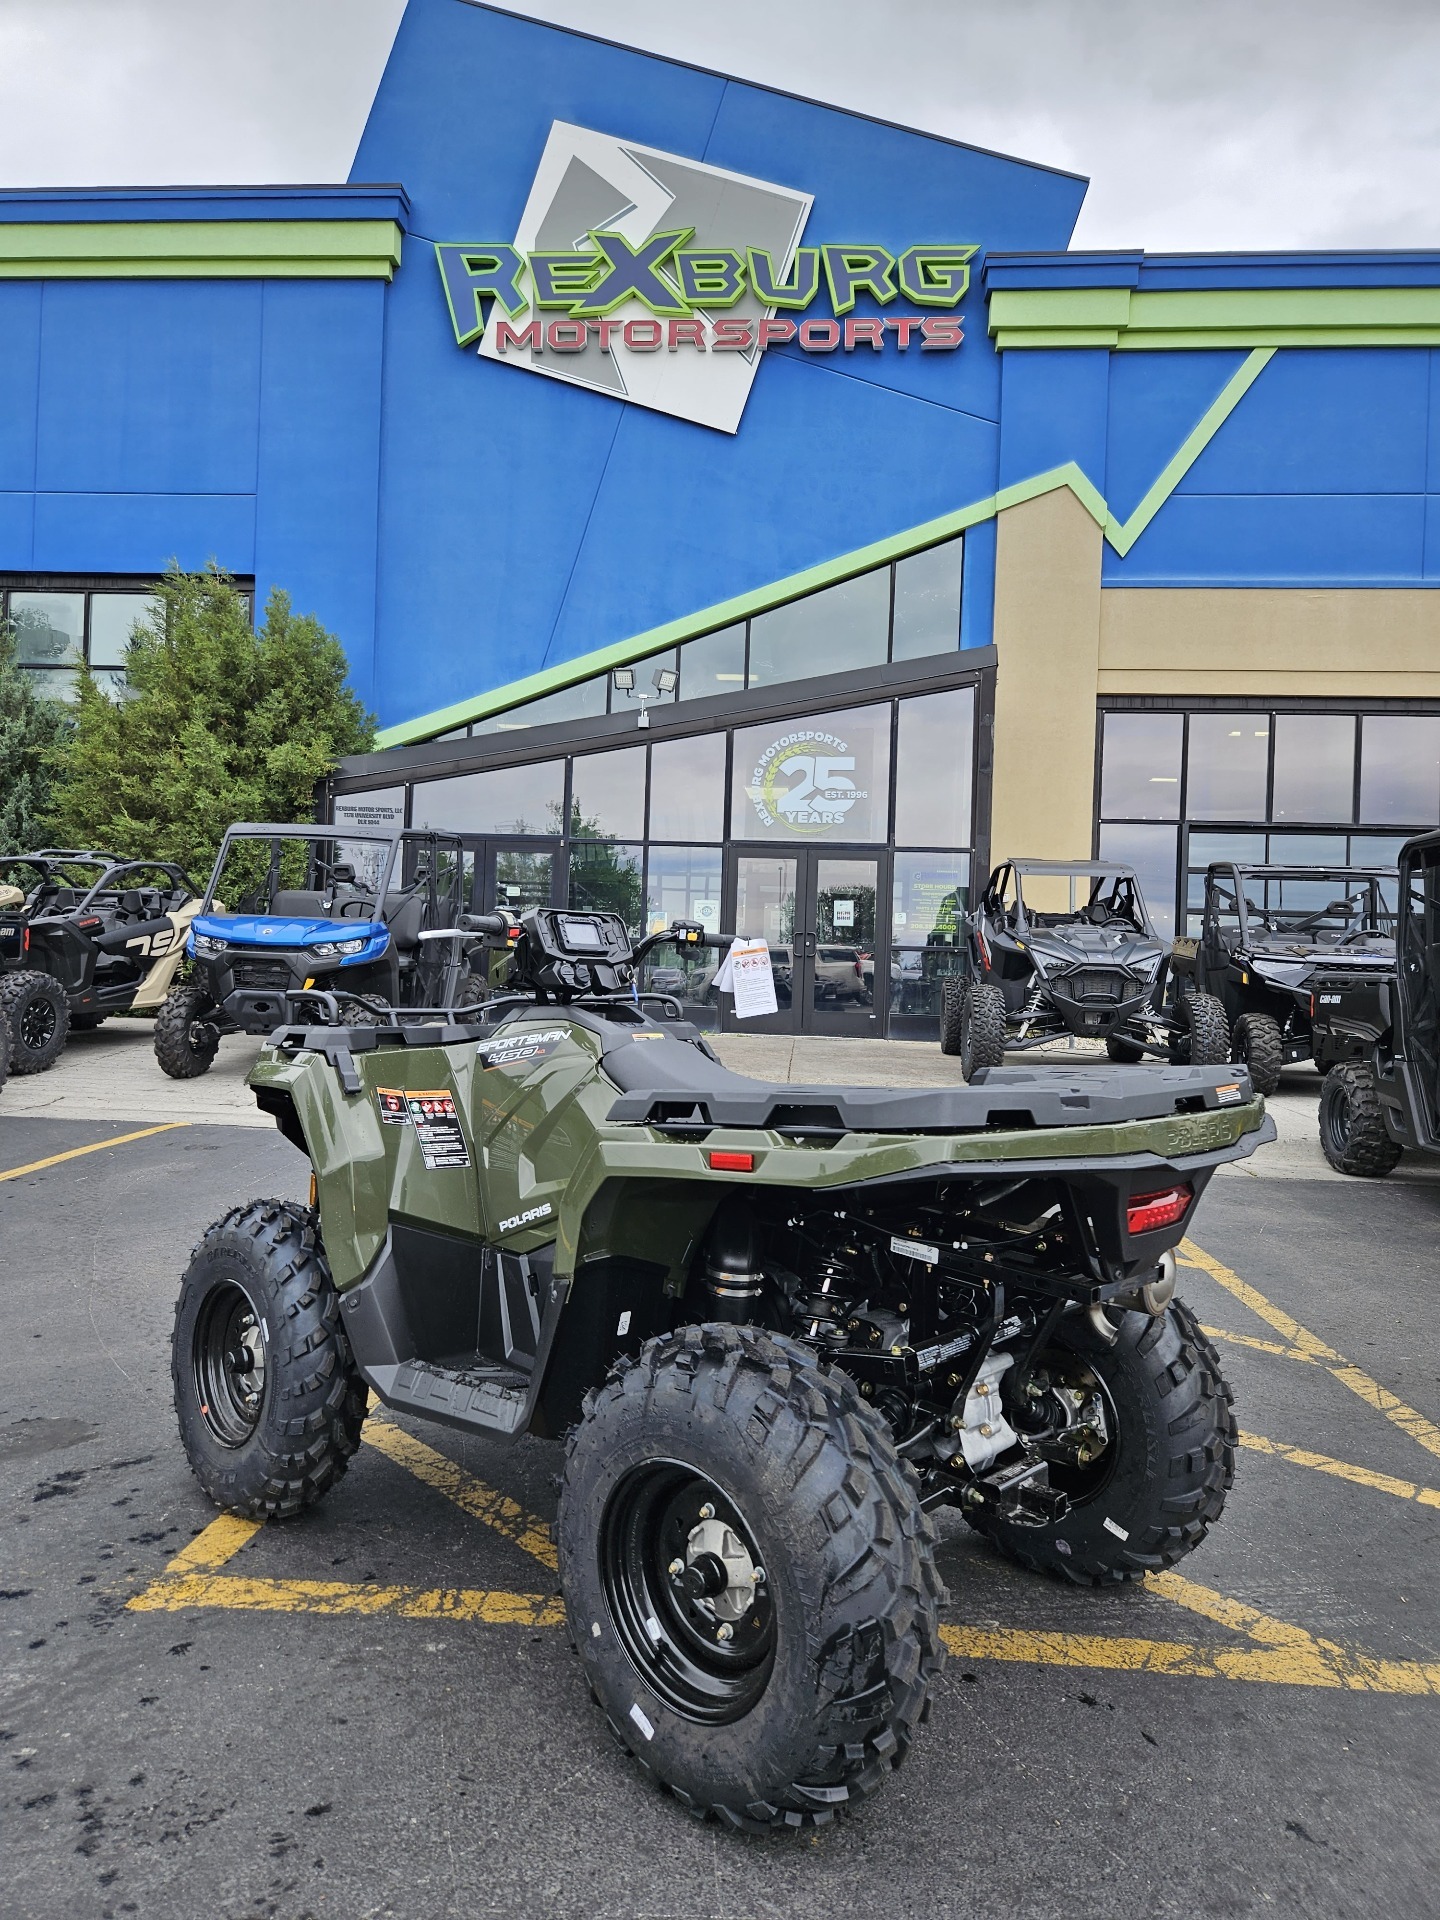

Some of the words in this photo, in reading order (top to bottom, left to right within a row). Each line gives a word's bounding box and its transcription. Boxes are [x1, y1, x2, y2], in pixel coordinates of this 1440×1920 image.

[435, 227, 981, 347] REXBURG
[496, 316, 966, 352] MOTORSPORTS
[758, 731, 848, 767] MOTORSPORTS
[752, 767, 774, 827] REXBURG
[776, 755, 856, 813] 25
[846, 791, 868, 799] 1996
[784, 811, 845, 824] YEARS
[476, 1029, 573, 1054] SPORTSMAN
[487, 1045, 539, 1063] 450
[498, 1202, 552, 1233] POLARIS
